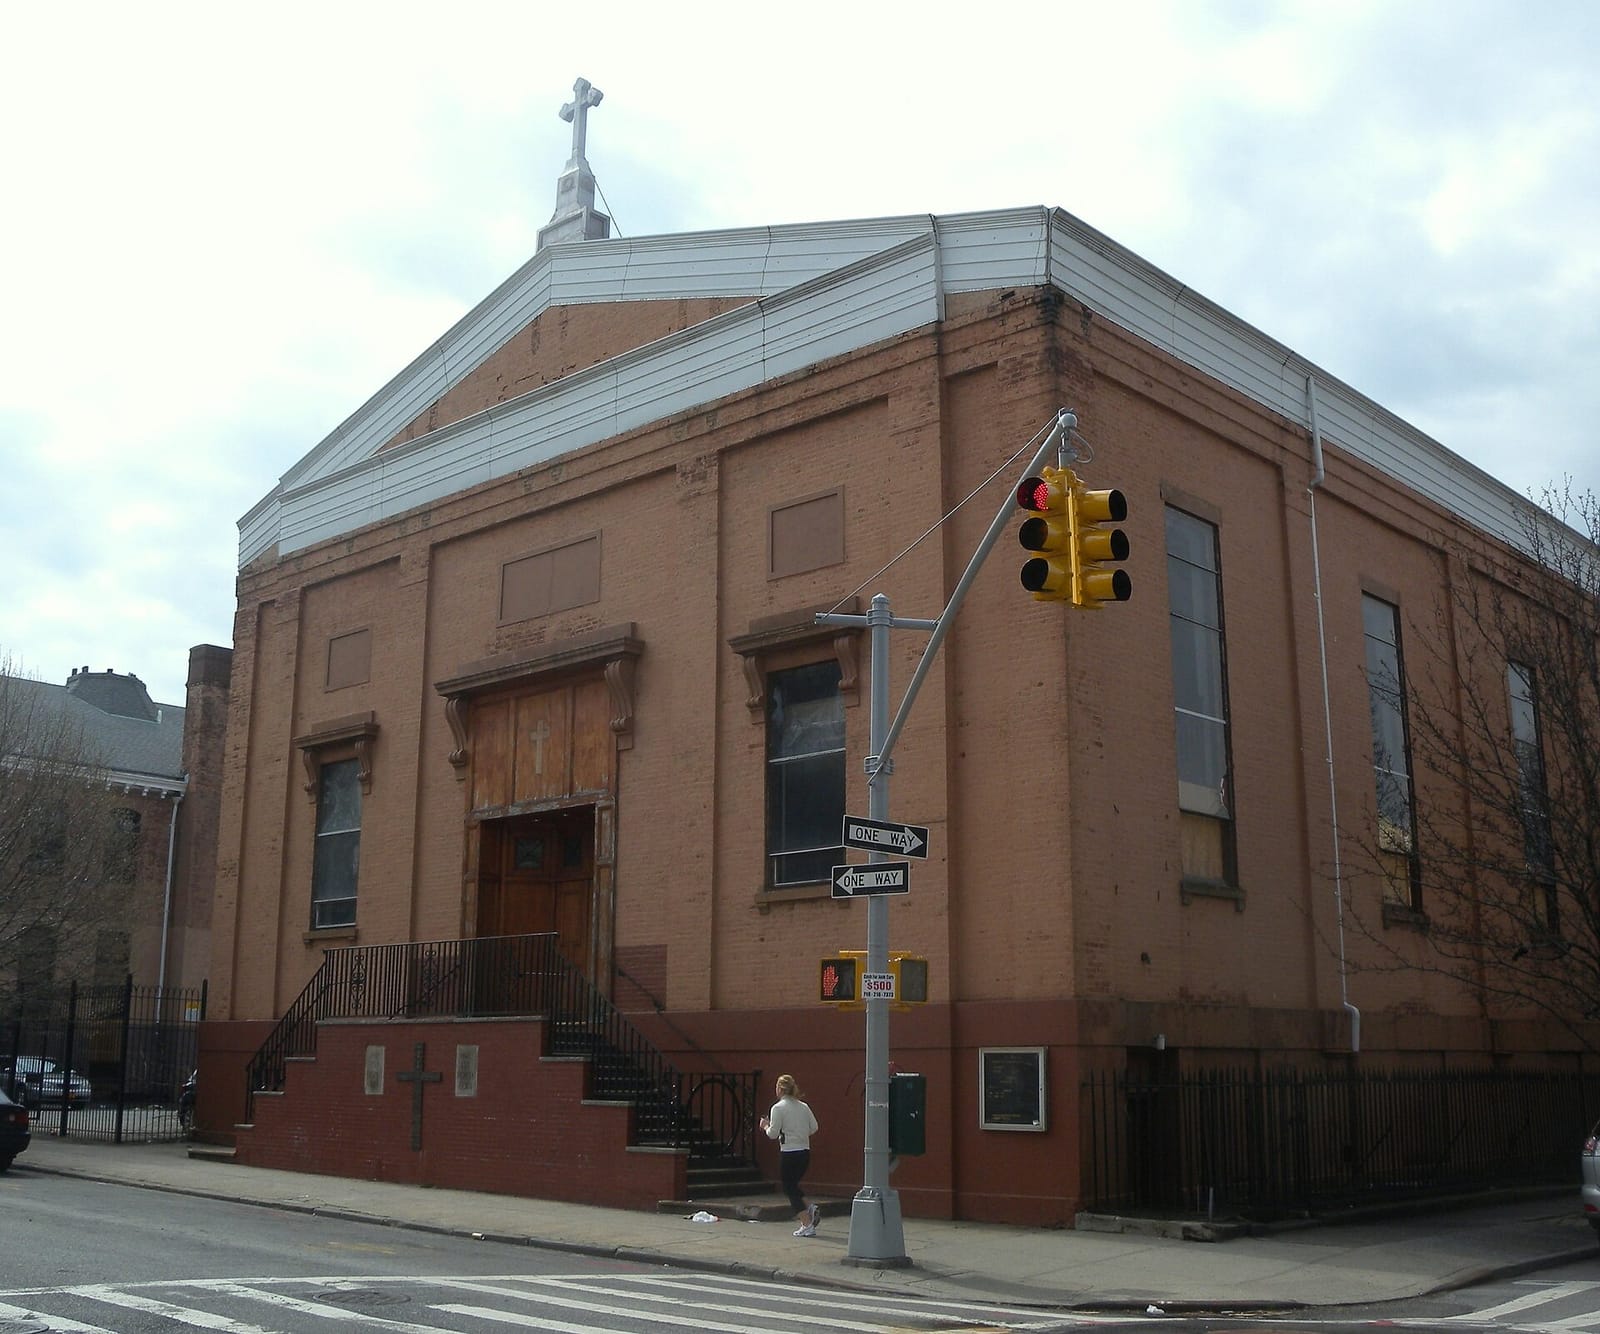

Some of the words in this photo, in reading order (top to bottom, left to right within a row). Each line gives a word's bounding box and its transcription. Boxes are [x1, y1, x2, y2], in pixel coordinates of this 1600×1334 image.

[855, 827, 880, 842] ONE
[890, 832, 915, 847] WAY
[843, 874, 865, 888] ONE
[875, 872, 899, 885] WAY
[867, 980, 892, 991] $500
